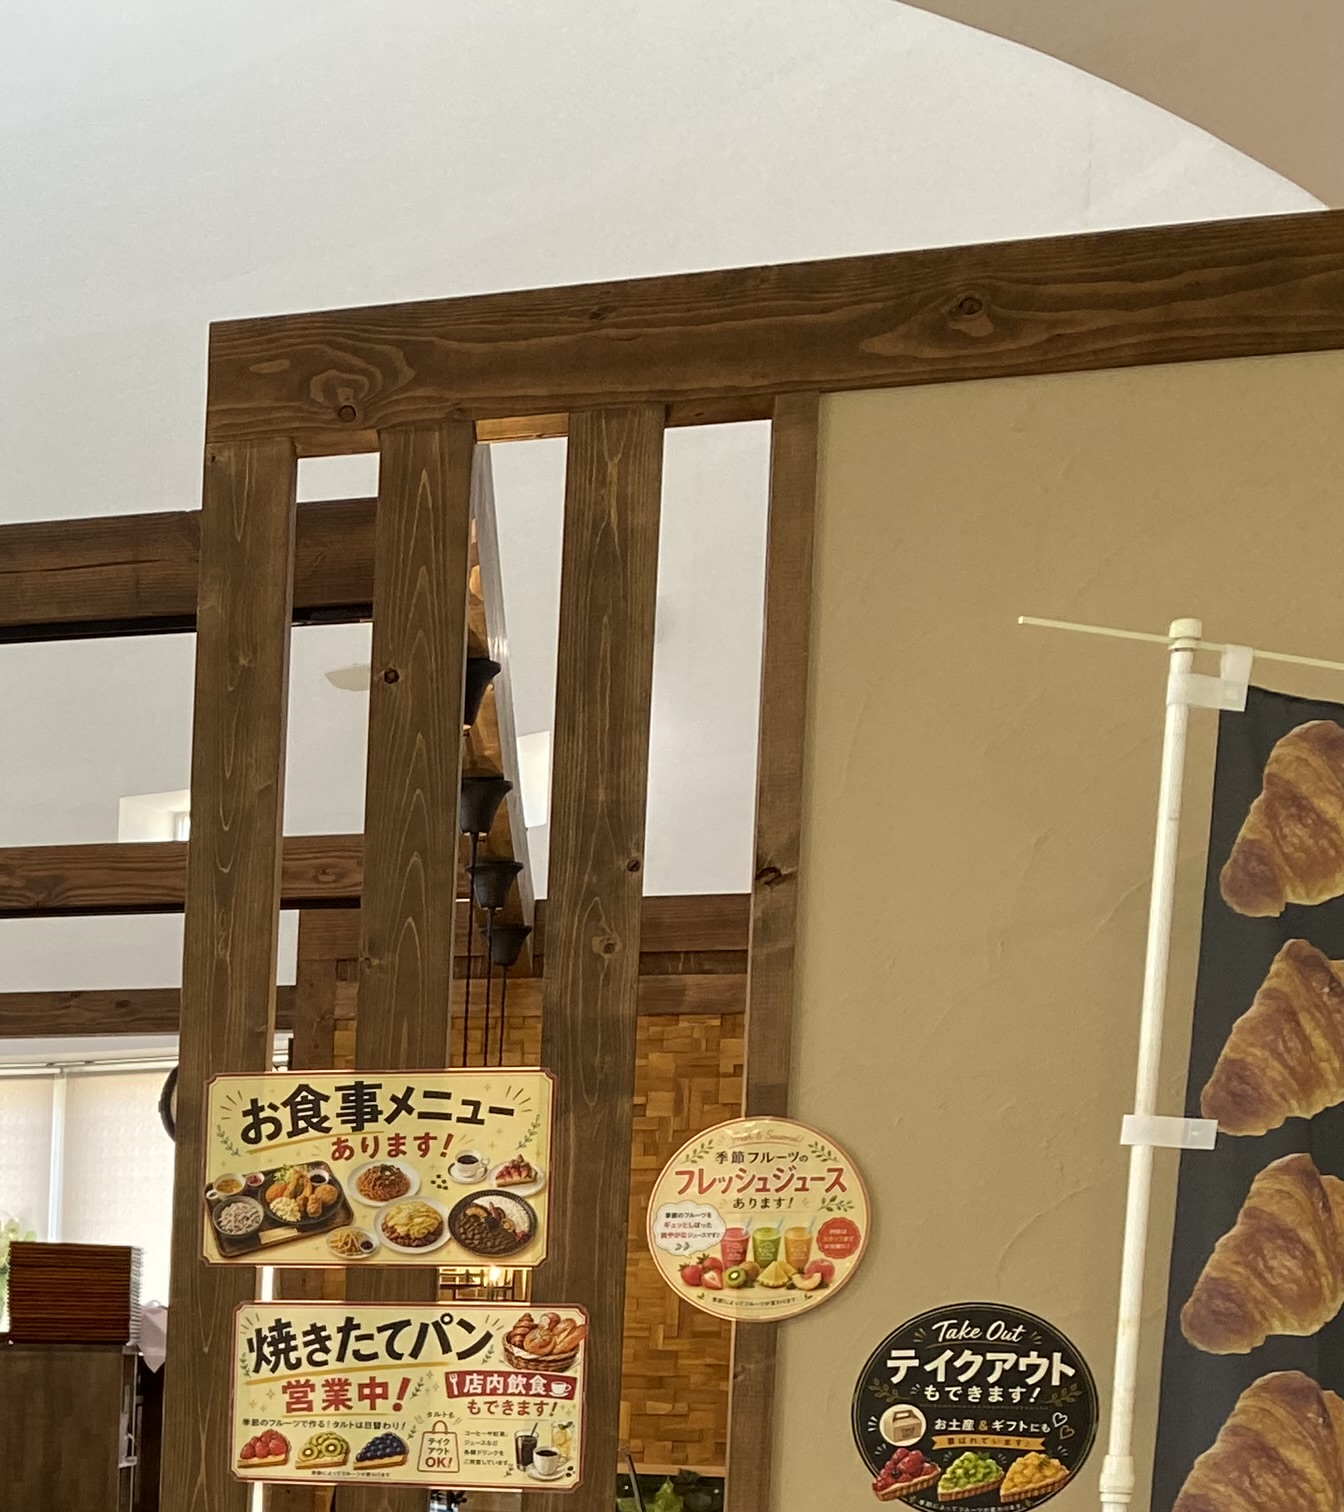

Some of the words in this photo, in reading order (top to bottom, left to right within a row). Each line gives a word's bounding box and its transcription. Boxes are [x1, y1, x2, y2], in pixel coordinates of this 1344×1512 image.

[240, 1080, 515, 1146] お食事メニュー
[330, 1133, 454, 1161] あります!
[715, 1151, 809, 1165] 季節フルーツの
[674, 1165, 847, 1195] フレッシュジュース
[733, 1197, 794, 1210] あります!
[932, 1320, 983, 1342] Take
[986, 1320, 1027, 1343] Out
[247, 1313, 494, 1374] 焼きたてパン
[887, 1349, 1076, 1386] テイクアウト
[464, 1373, 548, 1395] 店内飲食
[923, 1385, 1041, 1403] もできます!
[281, 1377, 412, 1414] 営業中!
[426, 1411, 456, 1419] タルトも
[467, 1400, 558, 1417] もできます!
[427, 1447, 450, 1456] アウト
[428, 1437, 450, 1446] テイク
[425, 1457, 453, 1468] OK!
